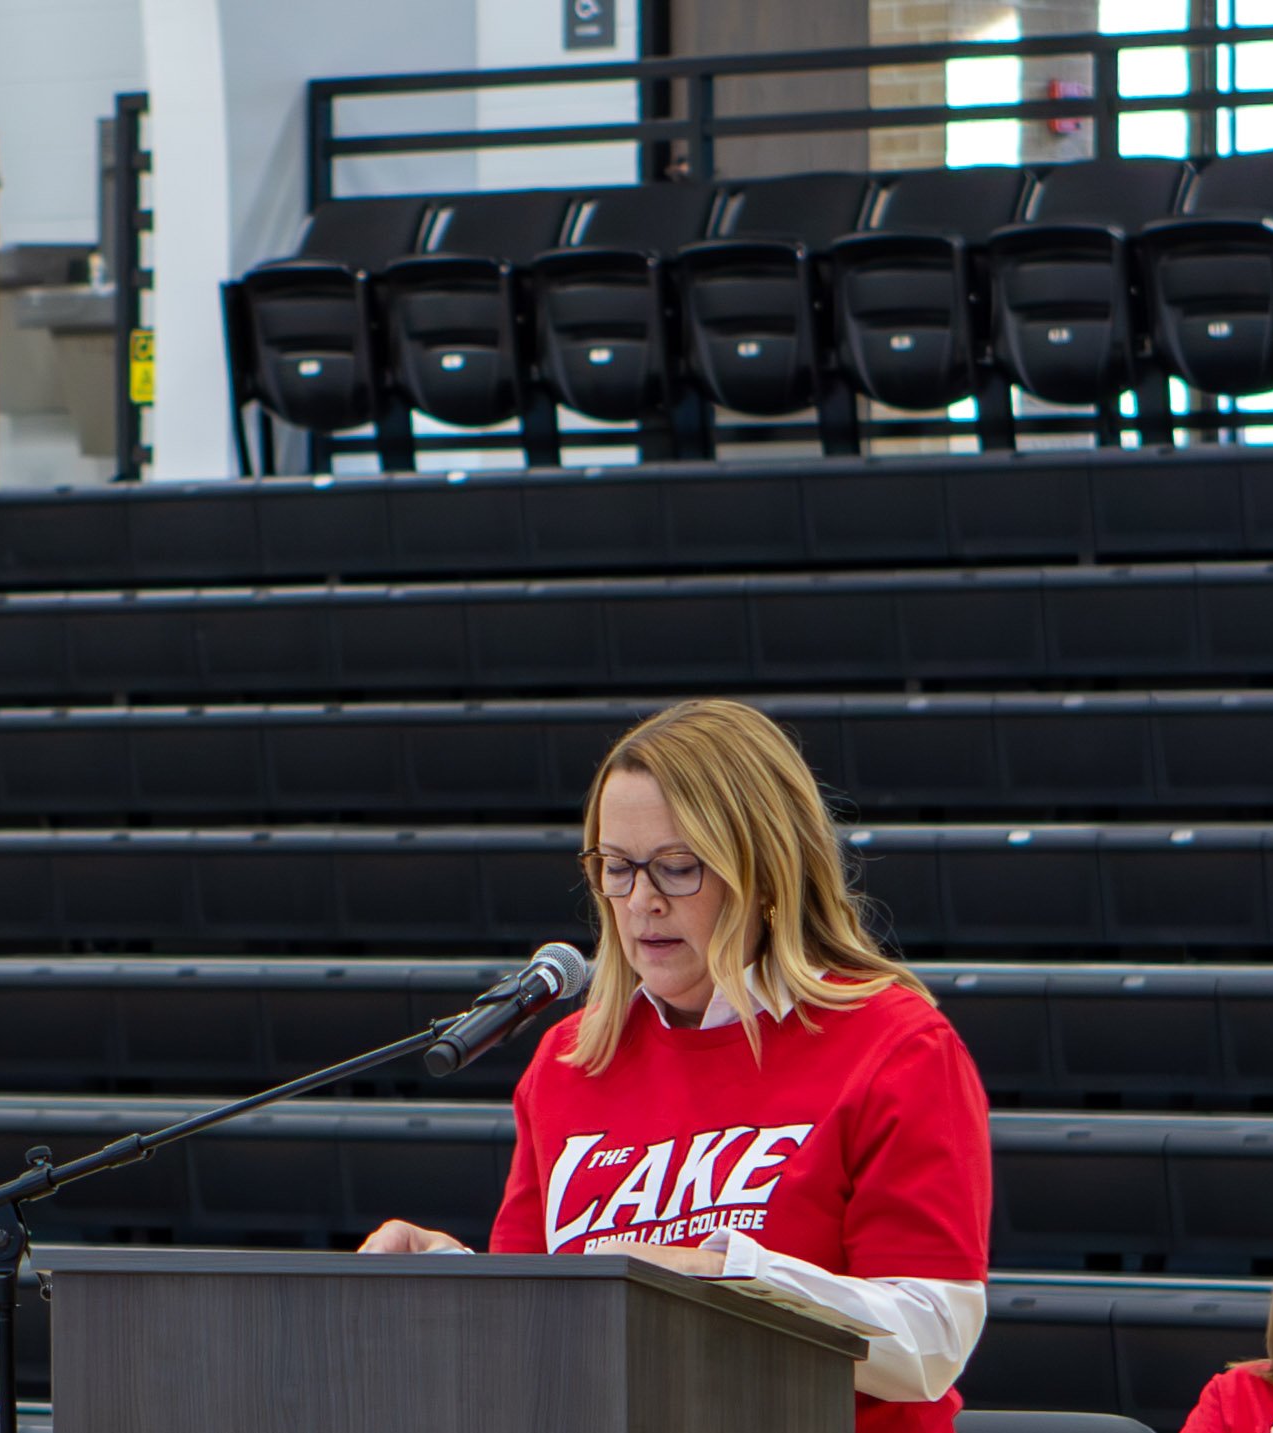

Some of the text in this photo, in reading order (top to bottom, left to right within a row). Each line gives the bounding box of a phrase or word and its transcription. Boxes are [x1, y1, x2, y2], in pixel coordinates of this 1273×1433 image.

[586, 1146, 635, 1169] THE
[545, 1123, 815, 1255] LAKE
[640, 1219, 687, 1245] LAKE
[688, 1209, 768, 1238] COLLEGE
